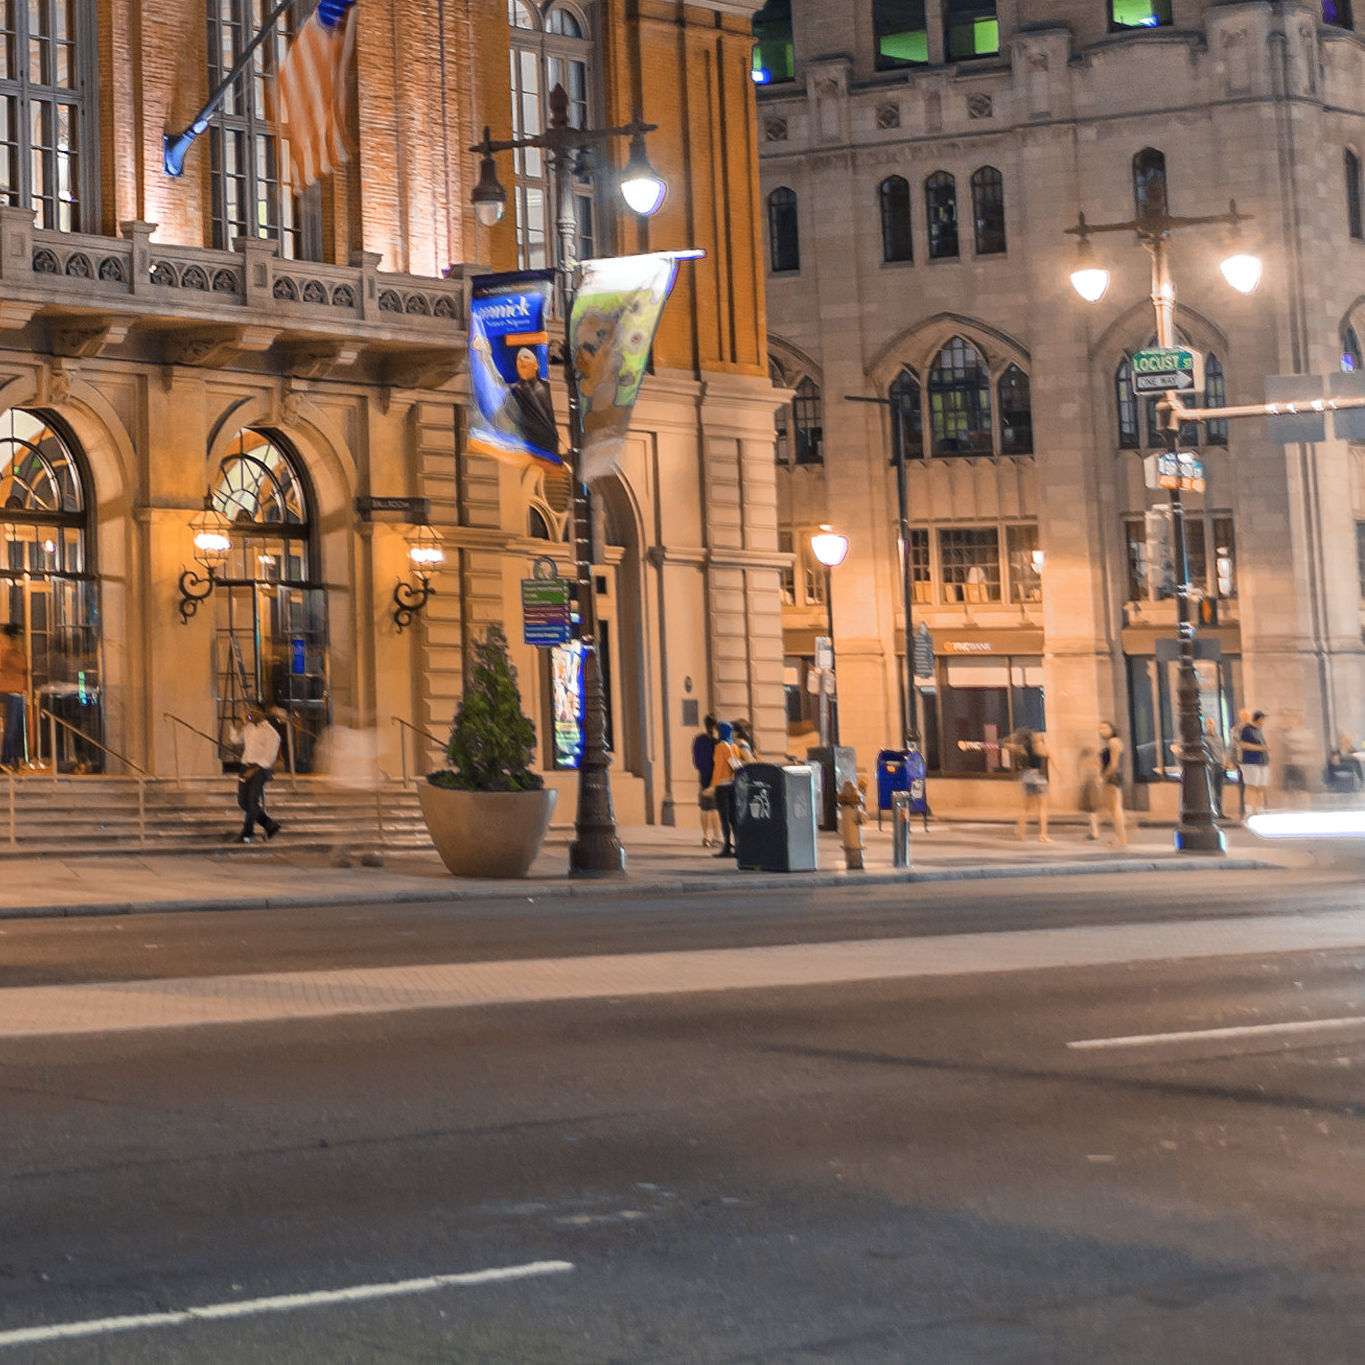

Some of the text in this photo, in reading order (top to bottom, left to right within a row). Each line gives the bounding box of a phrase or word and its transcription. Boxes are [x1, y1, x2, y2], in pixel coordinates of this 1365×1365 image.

[1133, 355, 1179, 372] LOCUST
[1140, 375, 1176, 389] ONE WAY
